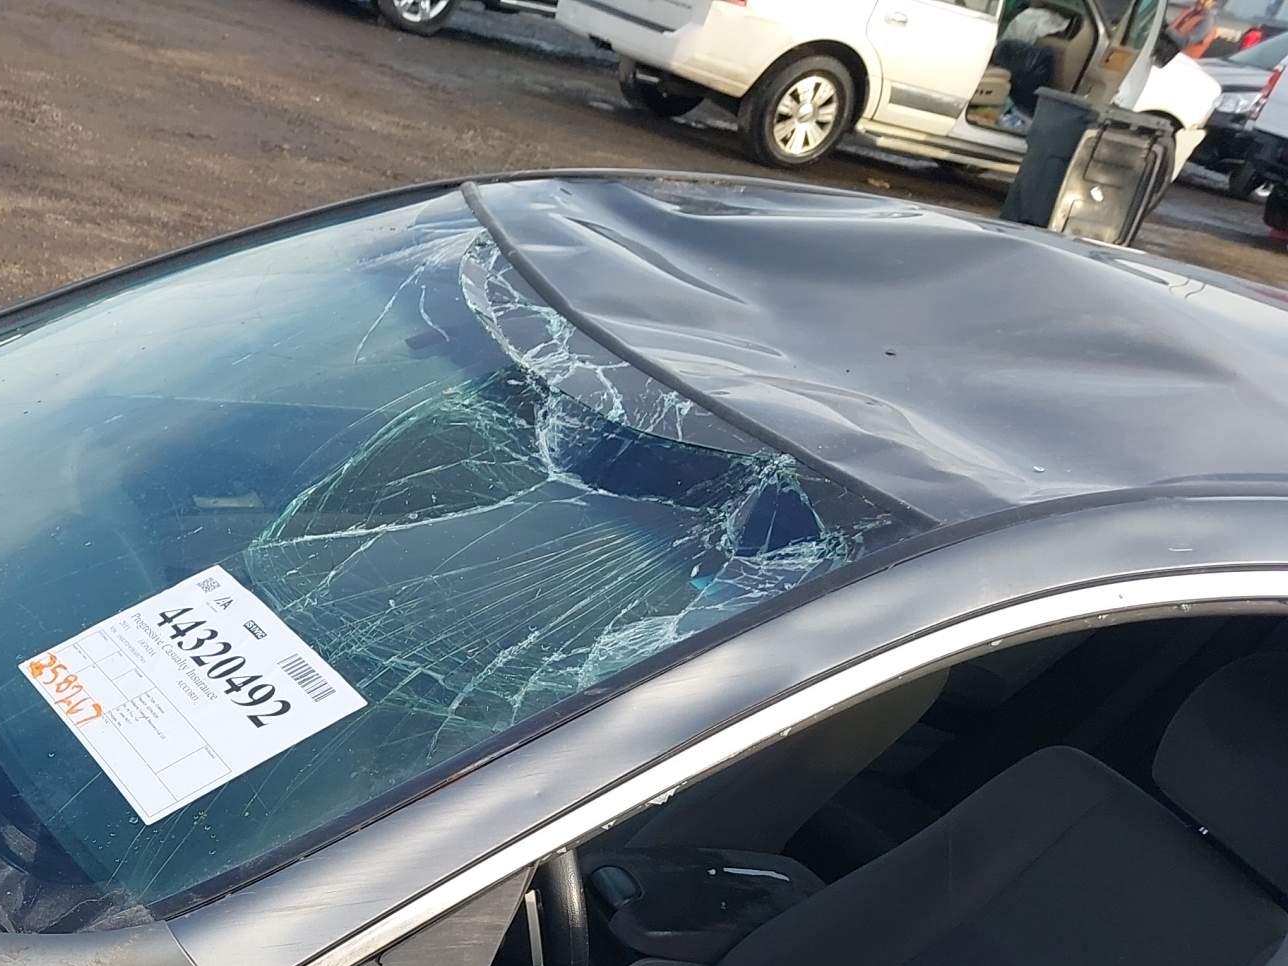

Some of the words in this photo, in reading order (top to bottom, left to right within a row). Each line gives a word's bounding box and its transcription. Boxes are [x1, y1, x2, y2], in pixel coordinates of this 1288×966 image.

[131, 612, 165, 646] Progressive
[160, 643, 190, 672] Casualty
[186, 668, 219, 701] Insurance
[157, 607, 292, 729] 44320492
